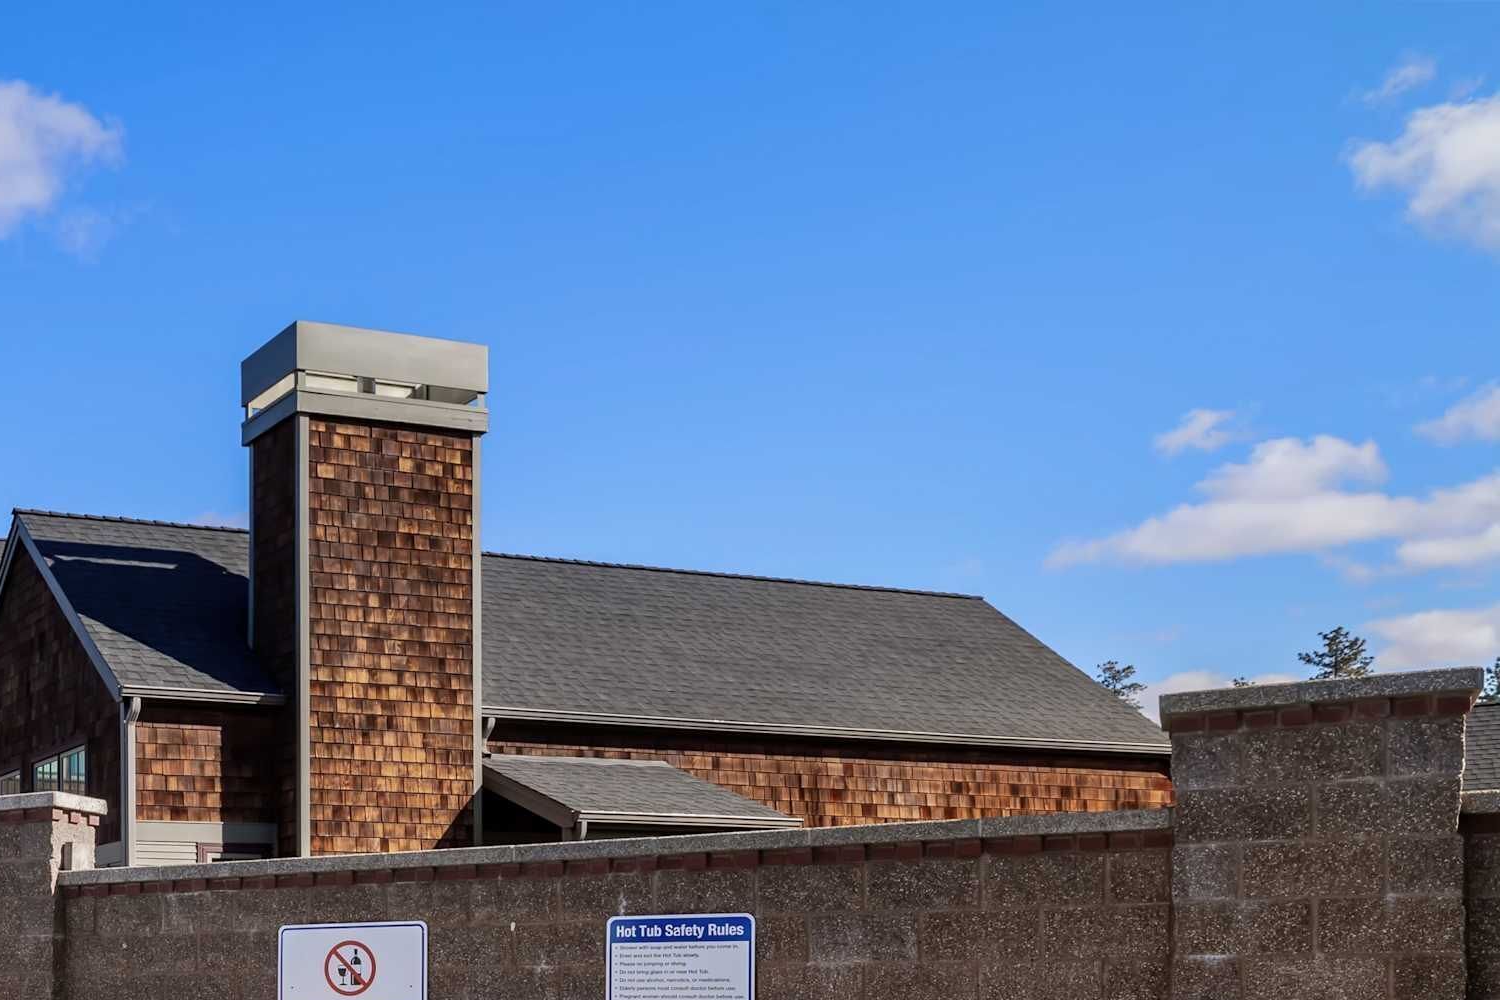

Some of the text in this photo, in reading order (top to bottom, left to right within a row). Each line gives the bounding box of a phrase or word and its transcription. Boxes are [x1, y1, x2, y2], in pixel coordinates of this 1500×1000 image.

[616, 923, 745, 939] Hot Tub Safety Rules
